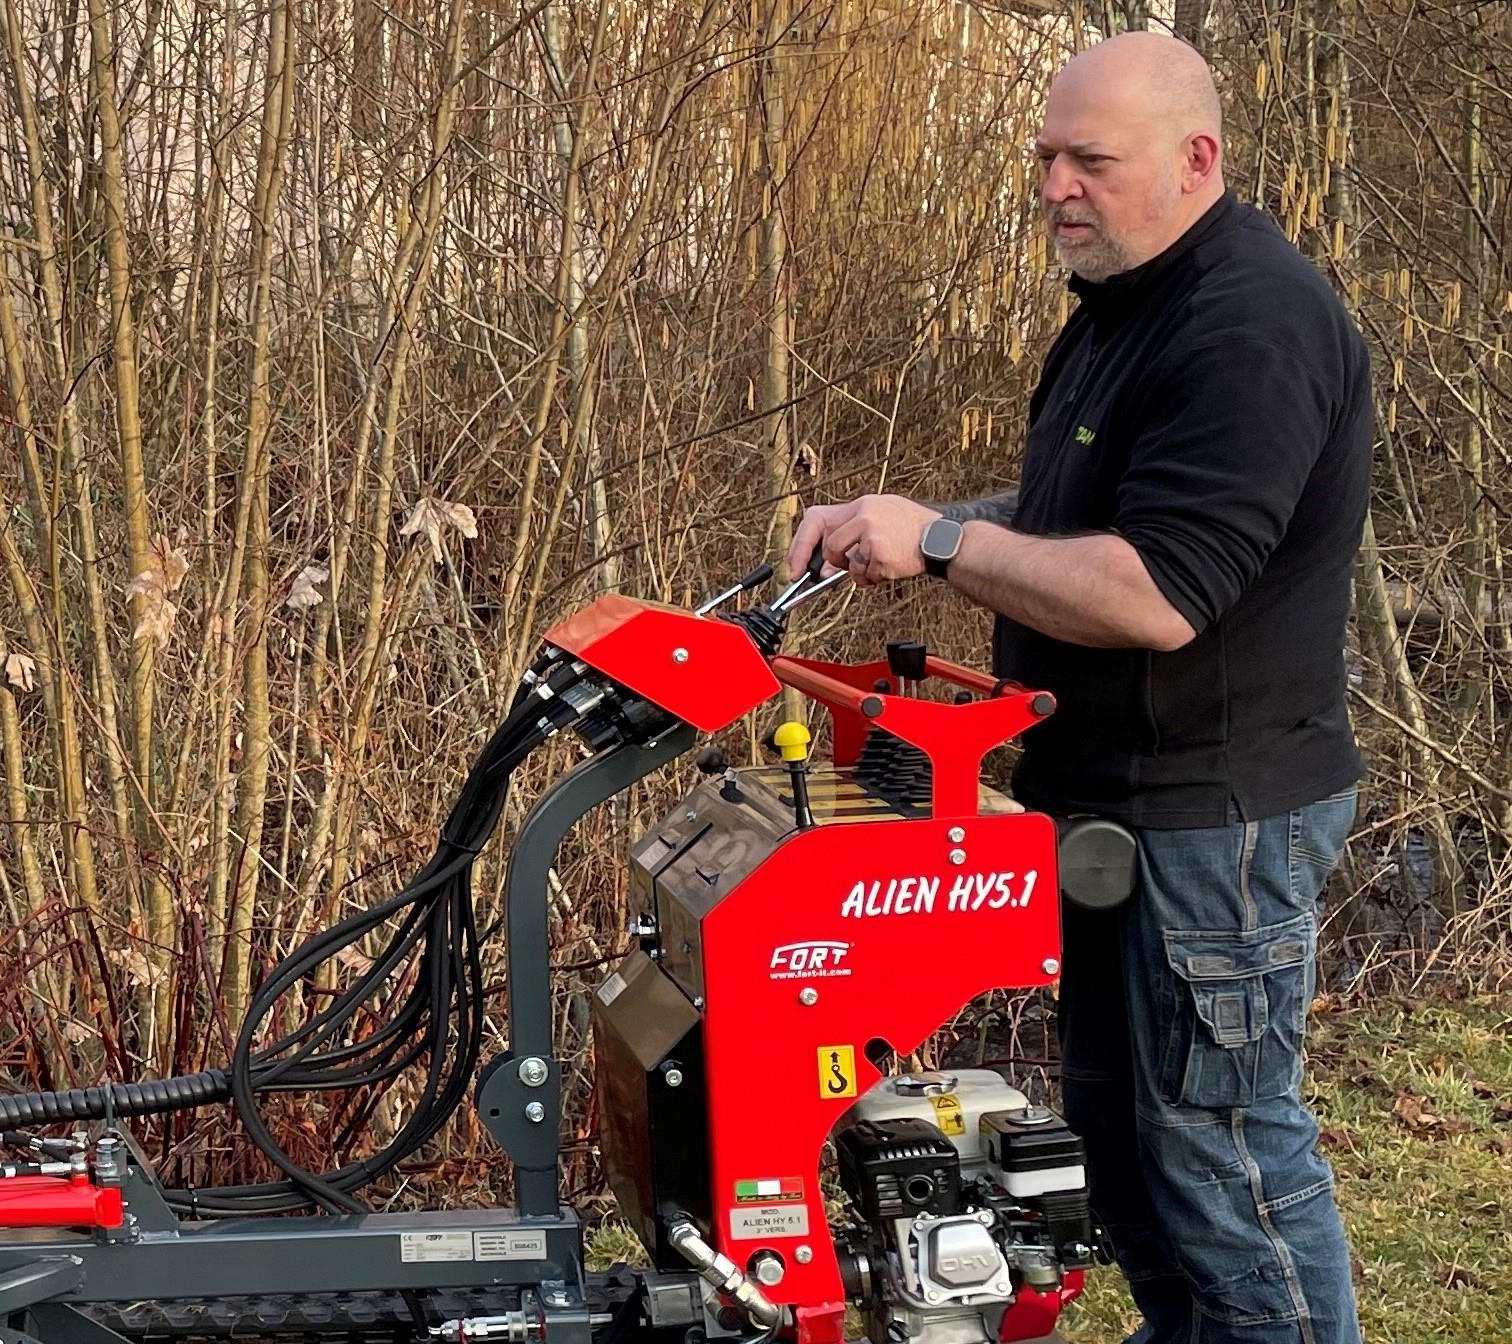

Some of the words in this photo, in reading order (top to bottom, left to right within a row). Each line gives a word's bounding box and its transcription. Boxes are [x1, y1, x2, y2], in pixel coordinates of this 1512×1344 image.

[841, 876, 940, 918] ALIEN
[948, 869, 1038, 912] HY5.1
[770, 941, 849, 970] FORT
[770, 969, 852, 979] www.fort-it.com
[743, 1218, 771, 1227] ALIEN
[773, 1217, 785, 1225] HY
